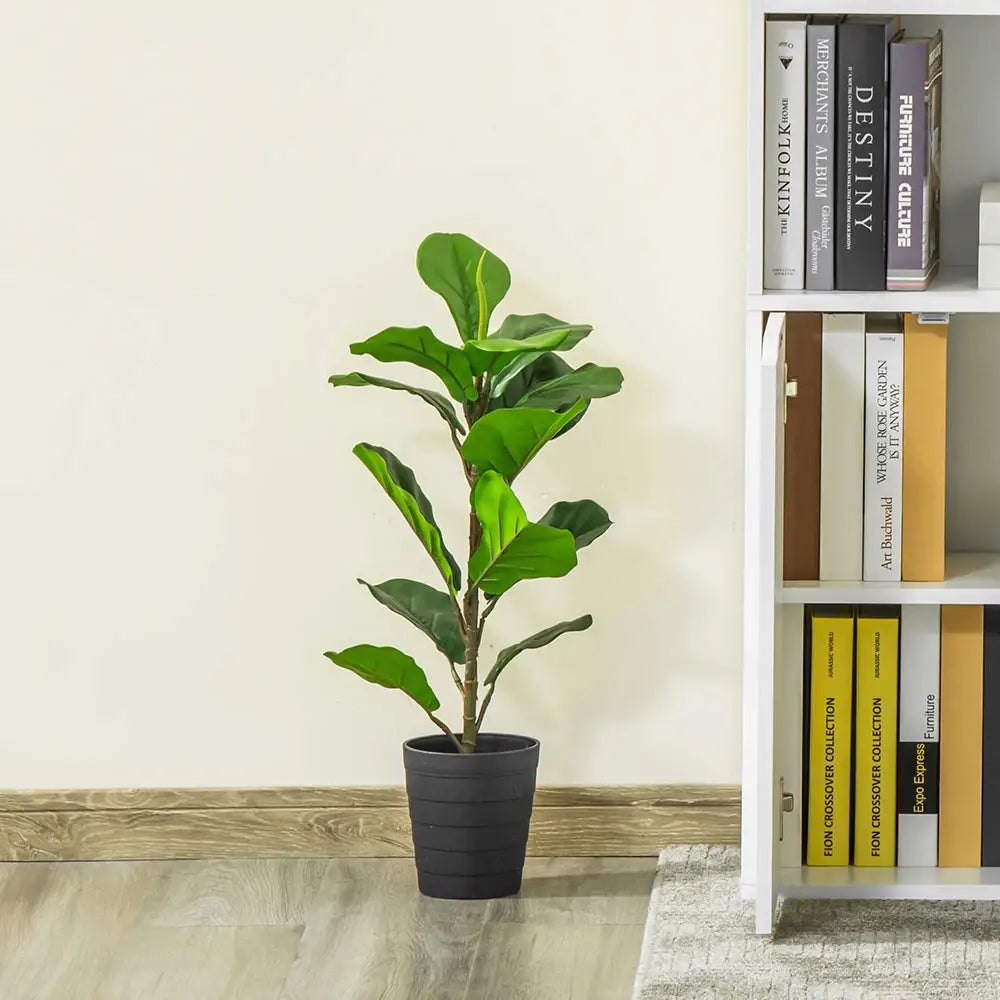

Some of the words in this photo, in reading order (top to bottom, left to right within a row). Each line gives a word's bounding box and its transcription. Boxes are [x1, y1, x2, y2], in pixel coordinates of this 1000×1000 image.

[816, 39, 829, 134] MERCHANTS
[778, 123, 791, 216] KINFOLK
[815, 145, 828, 198] ALBUM
[855, 86, 874, 231] DESTINY
[898, 183, 912, 247] CULTURE
[877, 360, 887, 407] GARDEN
[877, 411, 887, 438] ROSE
[890, 384, 900, 432] ANYWAY?
[877, 443, 887, 484] WHOSE
[890, 435, 899, 446] IT
[890, 451, 899, 459] IS
[881, 497, 893, 549] Buchwald
[881, 553, 893, 570] Art
[825, 697, 835, 762] COLLECTION
[872, 697, 882, 762] COLLECTION
[924, 694, 935, 740] Furniture
[914, 743, 926, 784] Express
[824, 764, 834, 828] CROSSOVER
[872, 765, 881, 828] CROSSOVER
[913, 786, 926, 813] Expo
[824, 832, 833, 856] FION
[872, 832, 880, 856] FION
